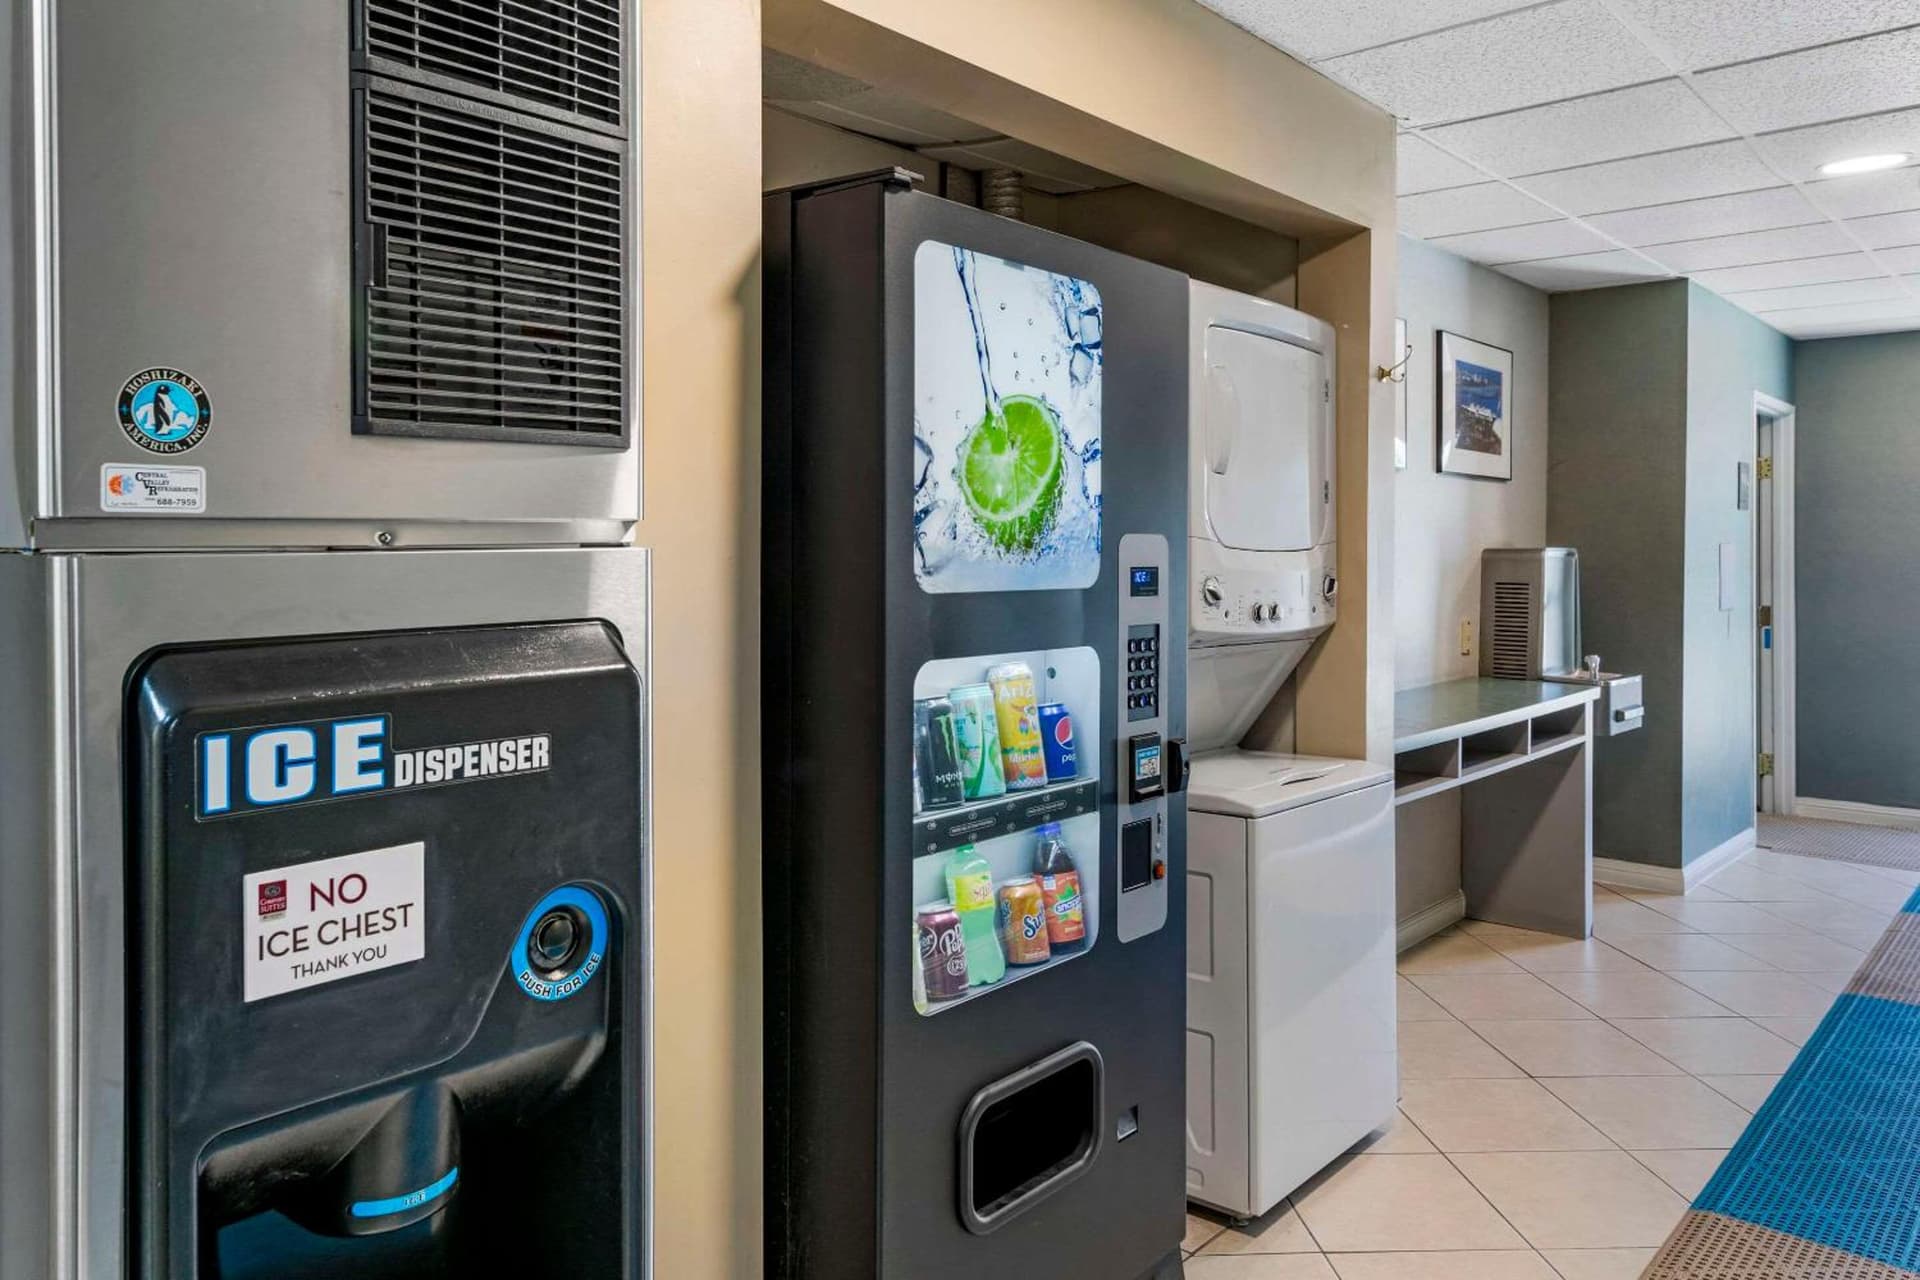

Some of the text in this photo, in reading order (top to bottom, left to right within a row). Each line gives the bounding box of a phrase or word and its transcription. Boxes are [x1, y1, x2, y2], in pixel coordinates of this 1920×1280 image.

[125, 369, 203, 397] HOSHIZAKI
[125, 423, 208, 451] AMERICA, INC.
[204, 717, 549, 814] ICE DISPENSER
[310, 873, 367, 911] NO
[258, 903, 414, 960] ICE CHEST
[291, 944, 388, 979] THANK YOU
[519, 953, 600, 997] PUSH FOR ICE
